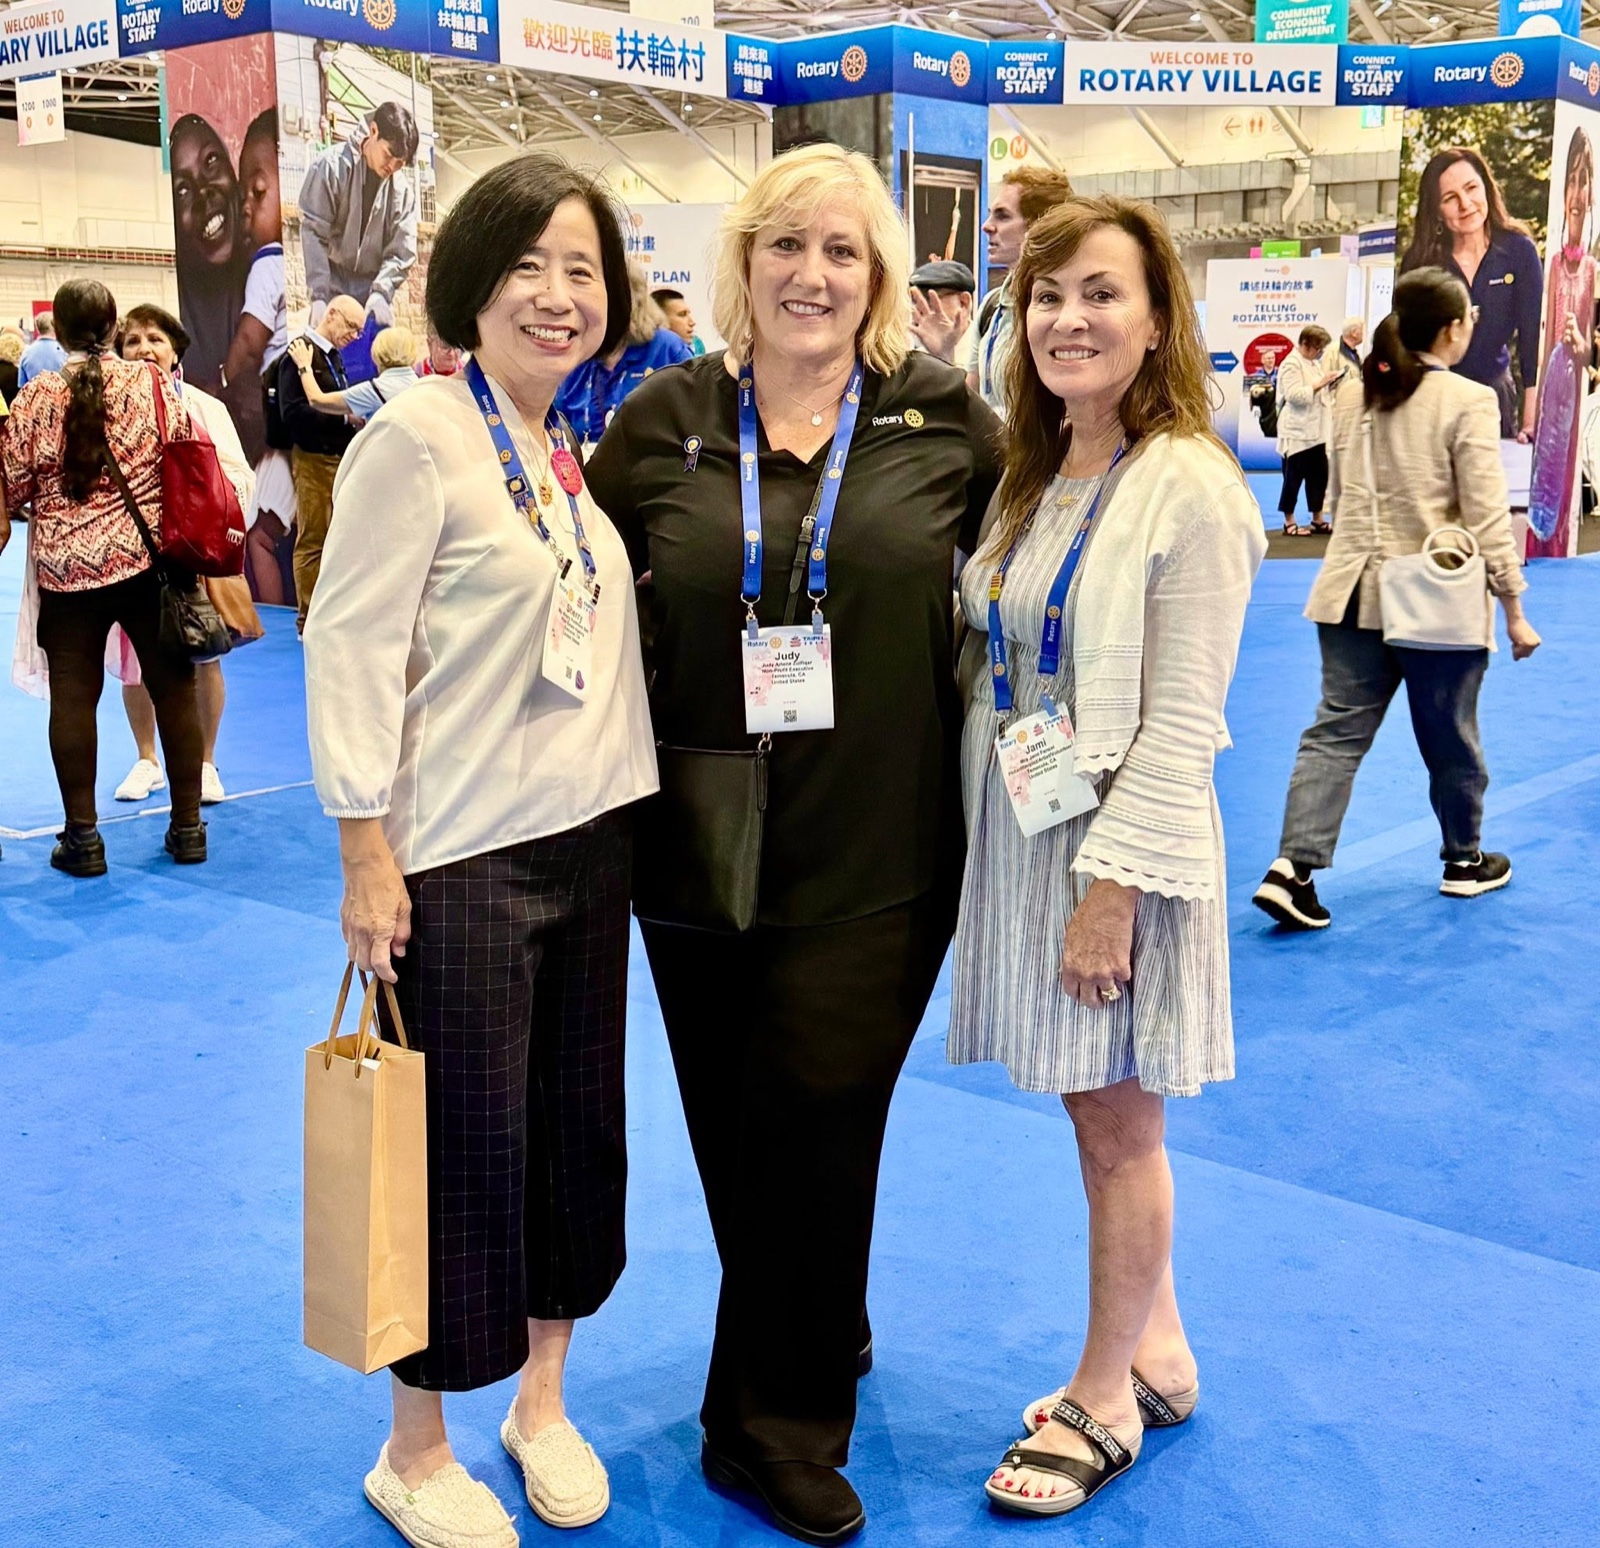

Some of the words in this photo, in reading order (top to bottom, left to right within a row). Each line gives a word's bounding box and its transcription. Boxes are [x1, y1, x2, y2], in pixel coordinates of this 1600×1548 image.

[182, 0, 219, 15] Rotary
[1270, 4, 1332, 21] COMMUNITY
[5, 13, 49, 34] WELCOME
[52, 9, 65, 24] TO
[122, 7, 161, 30] ROTARY
[1274, 15, 1327, 30] ECONOMIC
[36, 19, 109, 59] VILLAGE
[128, 24, 157, 44] STAFF
[1266, 24, 1336, 41] DEVELOPMENT
[913, 51, 949, 76] Rotary
[1004, 52, 1049, 62] CONNECT
[1150, 51, 1228, 65] WELCOME
[1233, 52, 1253, 65] TO
[1352, 56, 1396, 65] CONNECT
[797, 60, 839, 78] Rotary
[996, 66, 1056, 81] ROTARY
[1344, 69, 1403, 83] ROTARY
[1434, 66, 1487, 83] Rotary
[1568, 61, 1589, 86] Rotary
[1004, 80, 1047, 94] STAFF
[1079, 68, 1194, 92] ROTARY
[1202, 69, 1322, 93] VILLAGE
[1351, 83, 1394, 96] STAFF
[653, 271, 690, 283] PLAN
[1255, 304, 1297, 313] TELLING
[1232, 313, 1282, 323] ROTARY'S
[1284, 313, 1318, 323] STORY
[481, 394, 493, 414] Rotary
[872, 413, 903, 428] Rotary
[816, 527, 826, 548] Rotary
[749, 542, 757, 564] Rotary
[1048, 620, 1057, 643] Rotary
[775, 651, 800, 663] Judy
[1025, 738, 1047, 755] Jami
